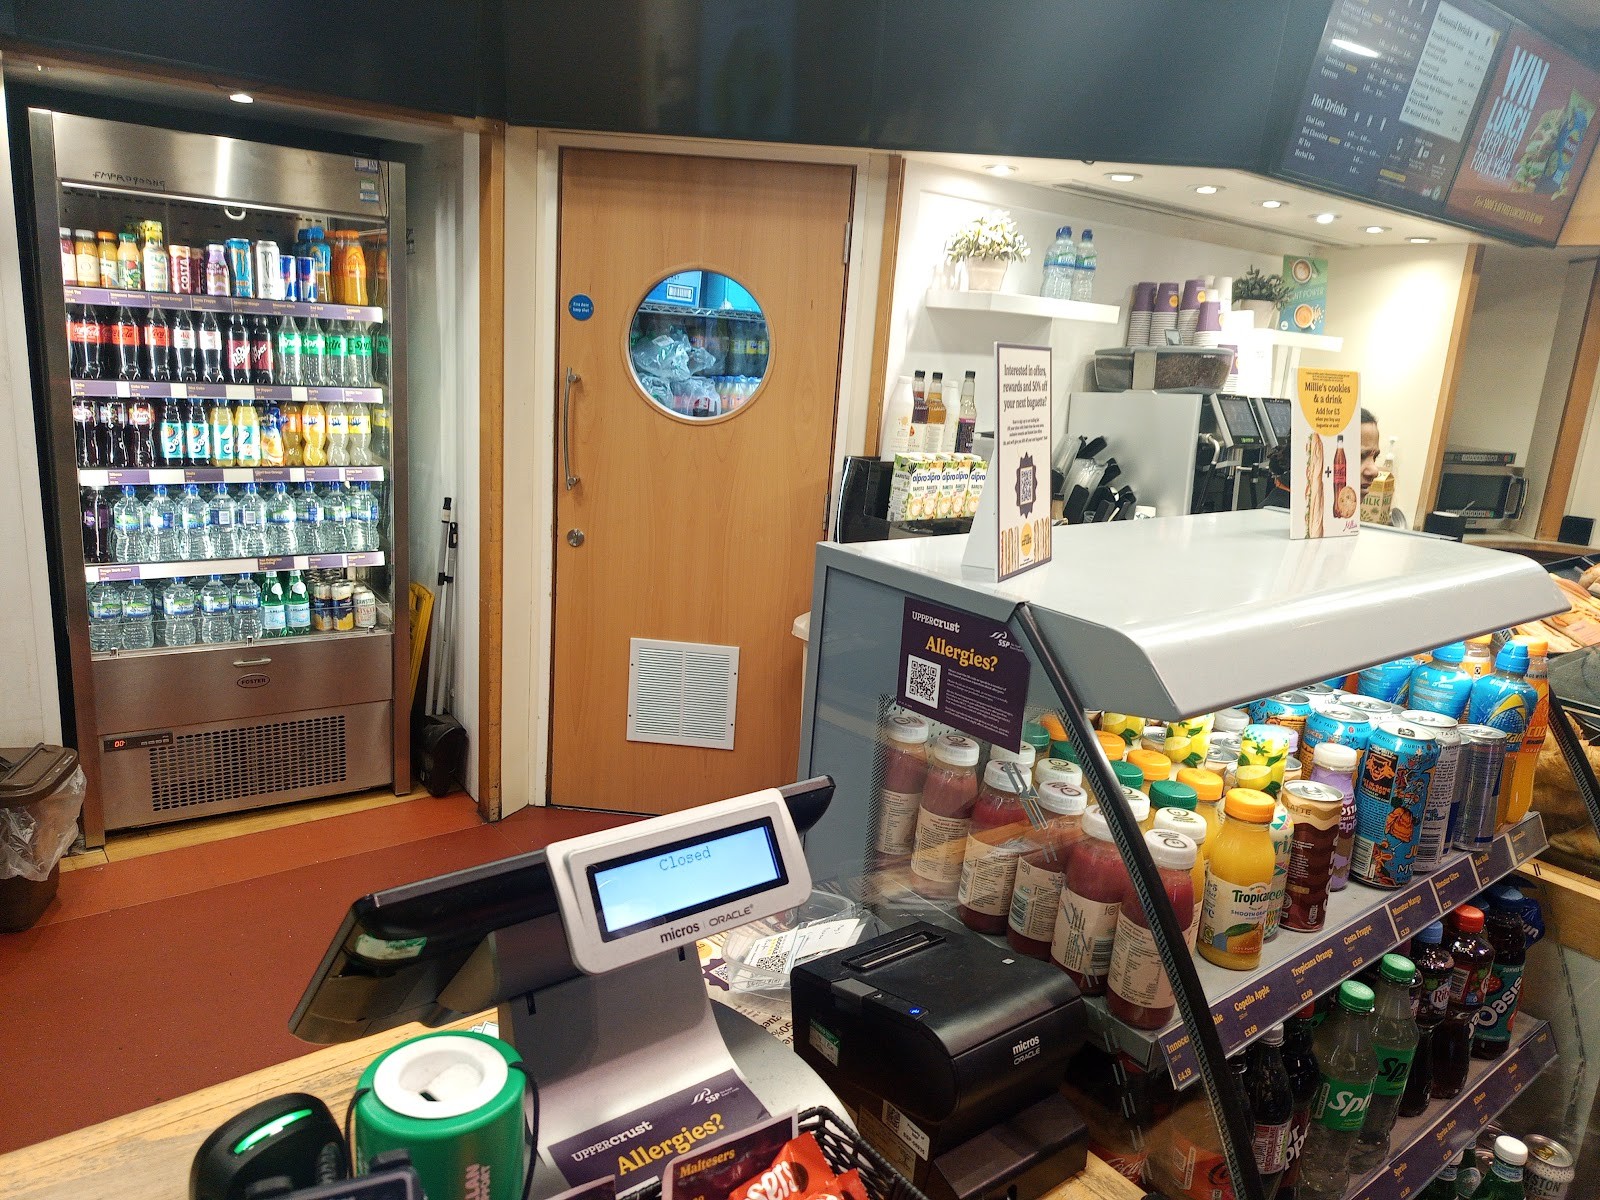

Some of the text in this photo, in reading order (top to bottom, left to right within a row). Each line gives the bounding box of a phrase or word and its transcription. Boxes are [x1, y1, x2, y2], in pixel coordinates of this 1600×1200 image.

[1502, 45, 1550, 111] WIN
[1310, 93, 1348, 117] Hot Drinks
[1486, 96, 1532, 142] LUNCH
[1478, 130, 1520, 163] EVERY DAY
[1470, 150, 1511, 182] FOR A YEAR
[180, 258, 188, 290] COSTA
[1004, 364, 1047, 378] Interested in offers,
[1003, 380, 1022, 392] rewards
[1023, 381, 1032, 392] and
[1032, 381, 1042, 392] 50%
[1305, 382, 1351, 394] Millie's cookies
[1004, 396, 1048, 412] your next baguette?
[1325, 395, 1342, 404] drink
[971, 472, 986, 482] alpro
[925, 636, 998, 672] Allergies?
[998, 639, 1010, 648] SSP
[1285, 802, 1312, 816] LATTE
[659, 846, 712, 872] Closed
[1392, 895, 1422, 916] Monster Mango
[660, 906, 752, 944] micros ORACLE
[1343, 925, 1373, 946] Costa Frappe
[1291, 948, 1334, 978] Tropicana Orange
[1234, 985, 1271, 1012] Copella Apple
[1012, 1035, 1040, 1055] micros
[1013, 1048, 1041, 1066] ORACLE
[704, 1092, 720, 1104] SSP
[616, 1113, 725, 1176] Allergies?
[1436, 1127, 1448, 1141] Sprite
[679, 1149, 736, 1179] Maltesers
[1394, 1162, 1407, 1177] Sprite
